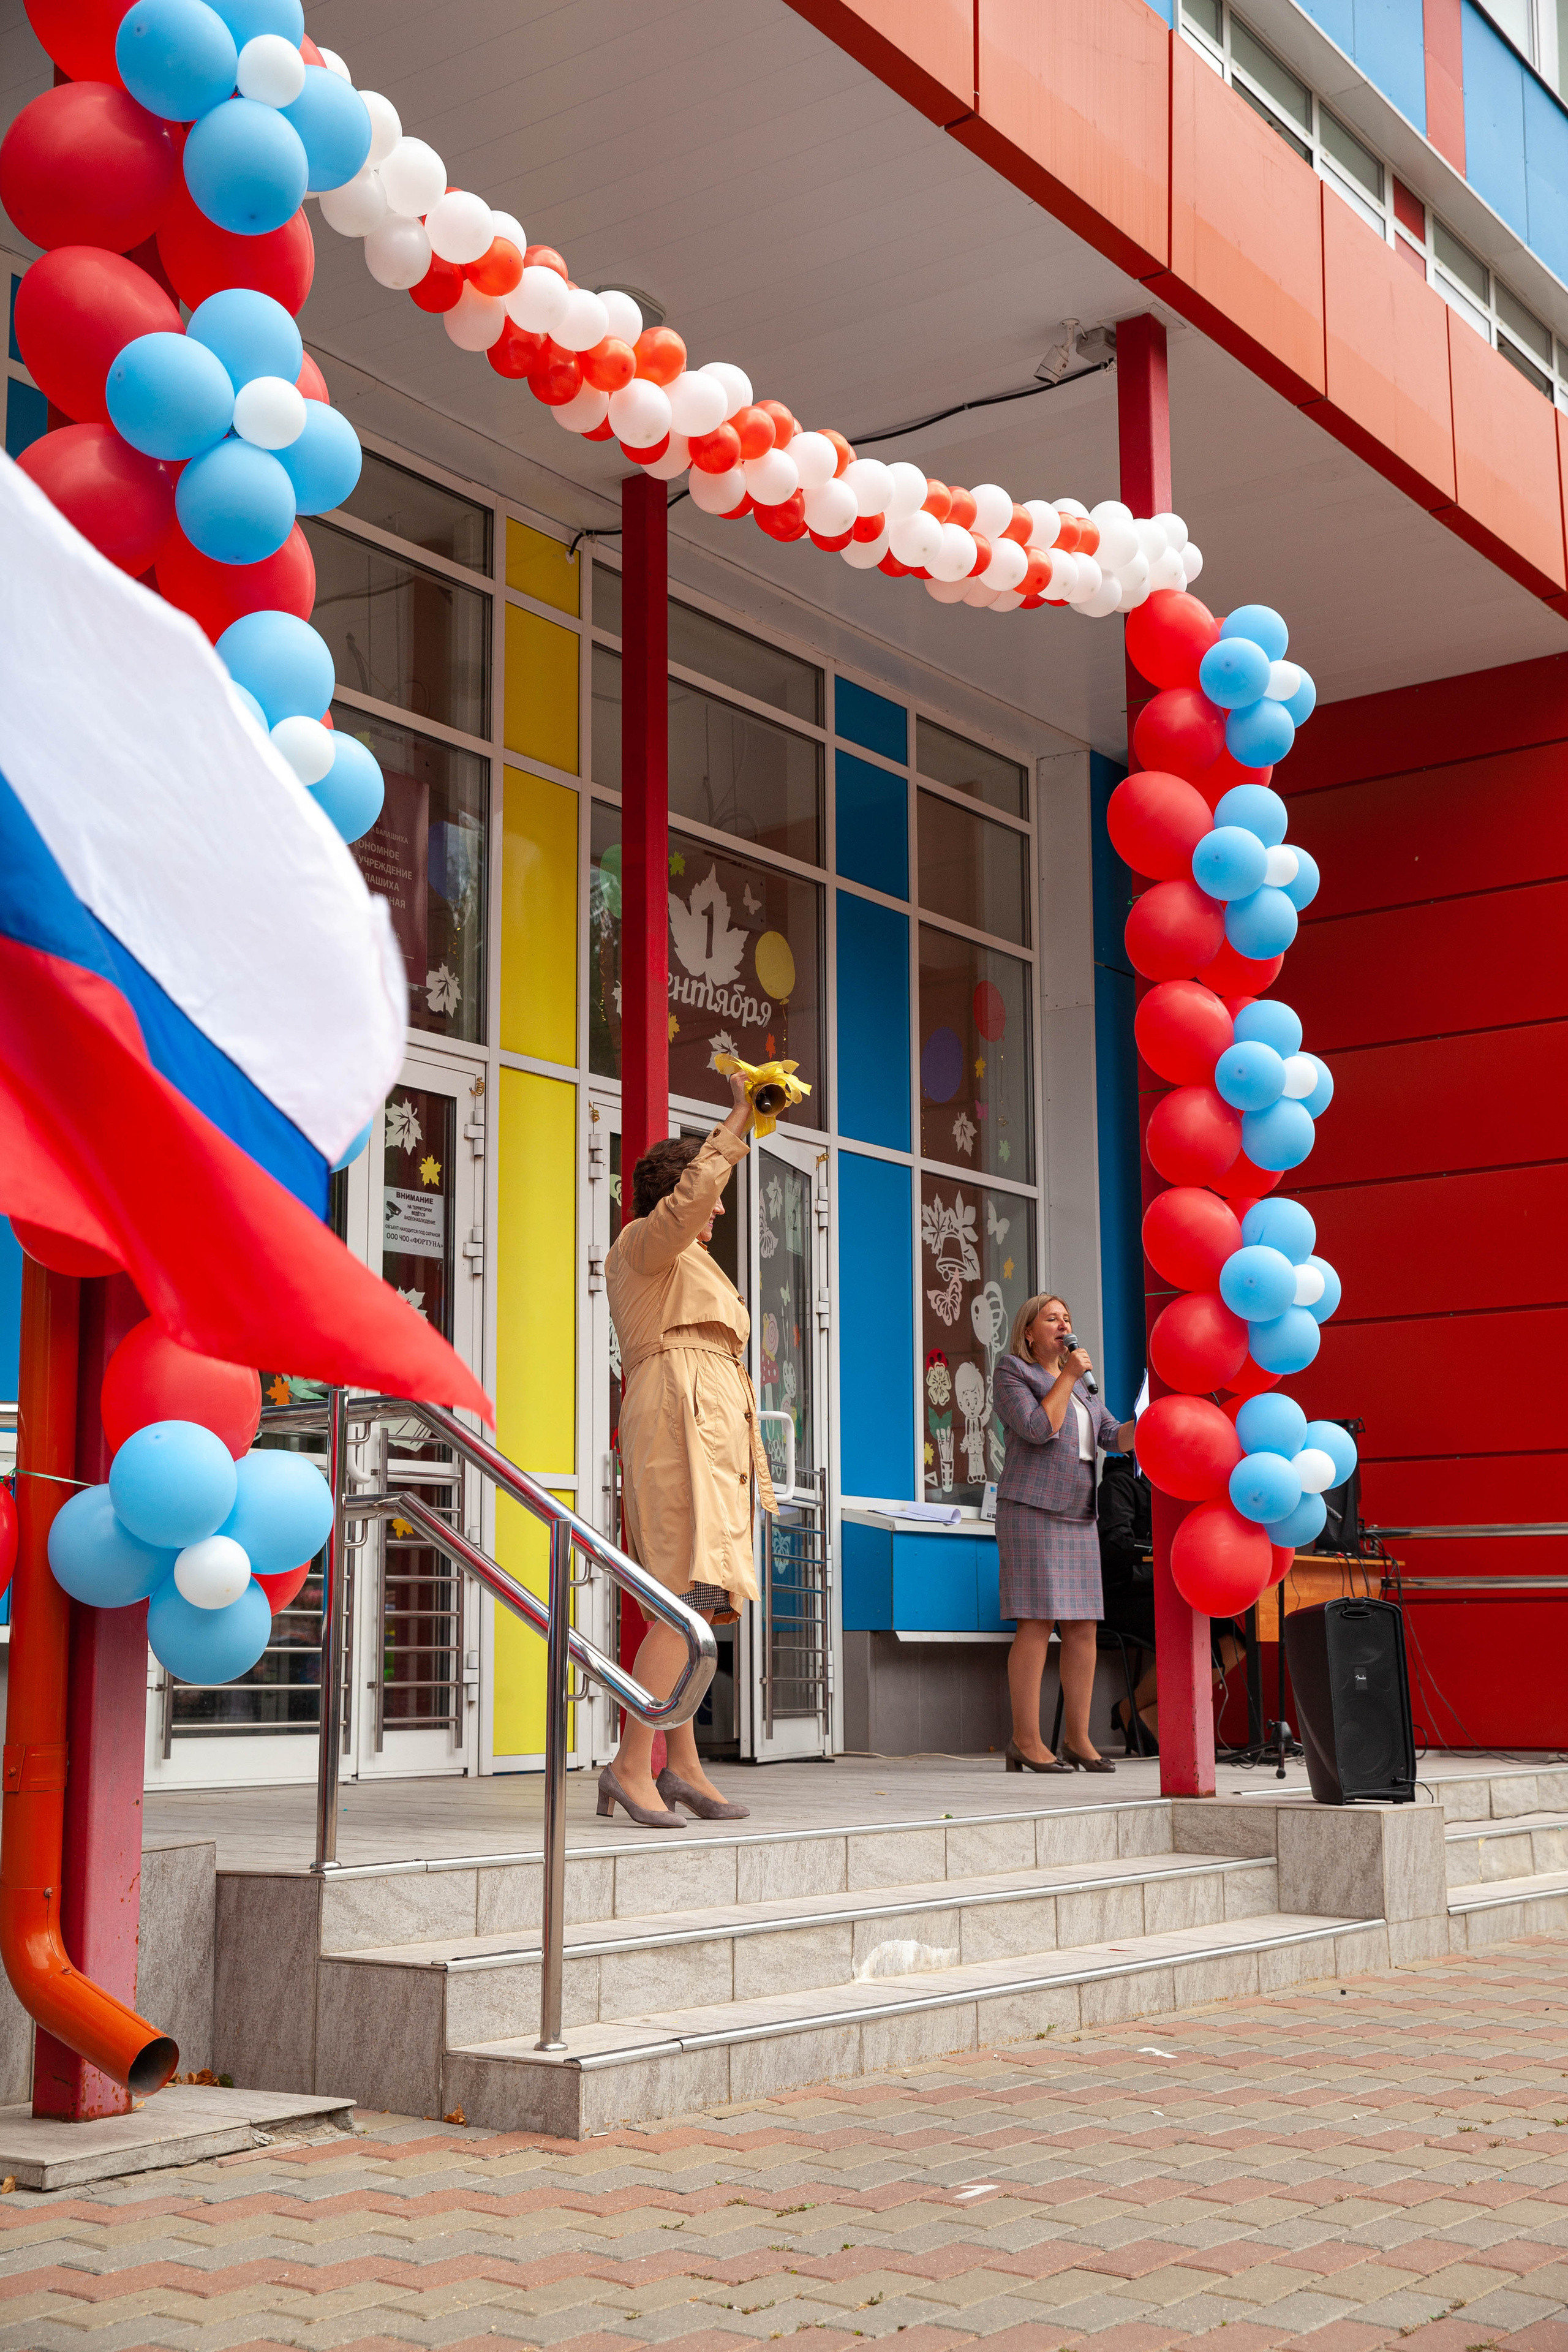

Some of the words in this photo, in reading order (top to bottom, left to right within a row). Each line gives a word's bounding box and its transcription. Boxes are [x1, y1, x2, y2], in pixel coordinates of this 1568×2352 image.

[375, 827, 409, 844] БАЛАШИХА
[359, 854, 412, 880] УЧРЕЖДЕНИЕ
[364, 872, 399, 891] ЛАШИХА
[701, 902, 714, 959] 1
[396, 1191, 434, 1205] ВНИМАНИЕ
[410, 1237, 443, 1248] «ФОРТУНА»
